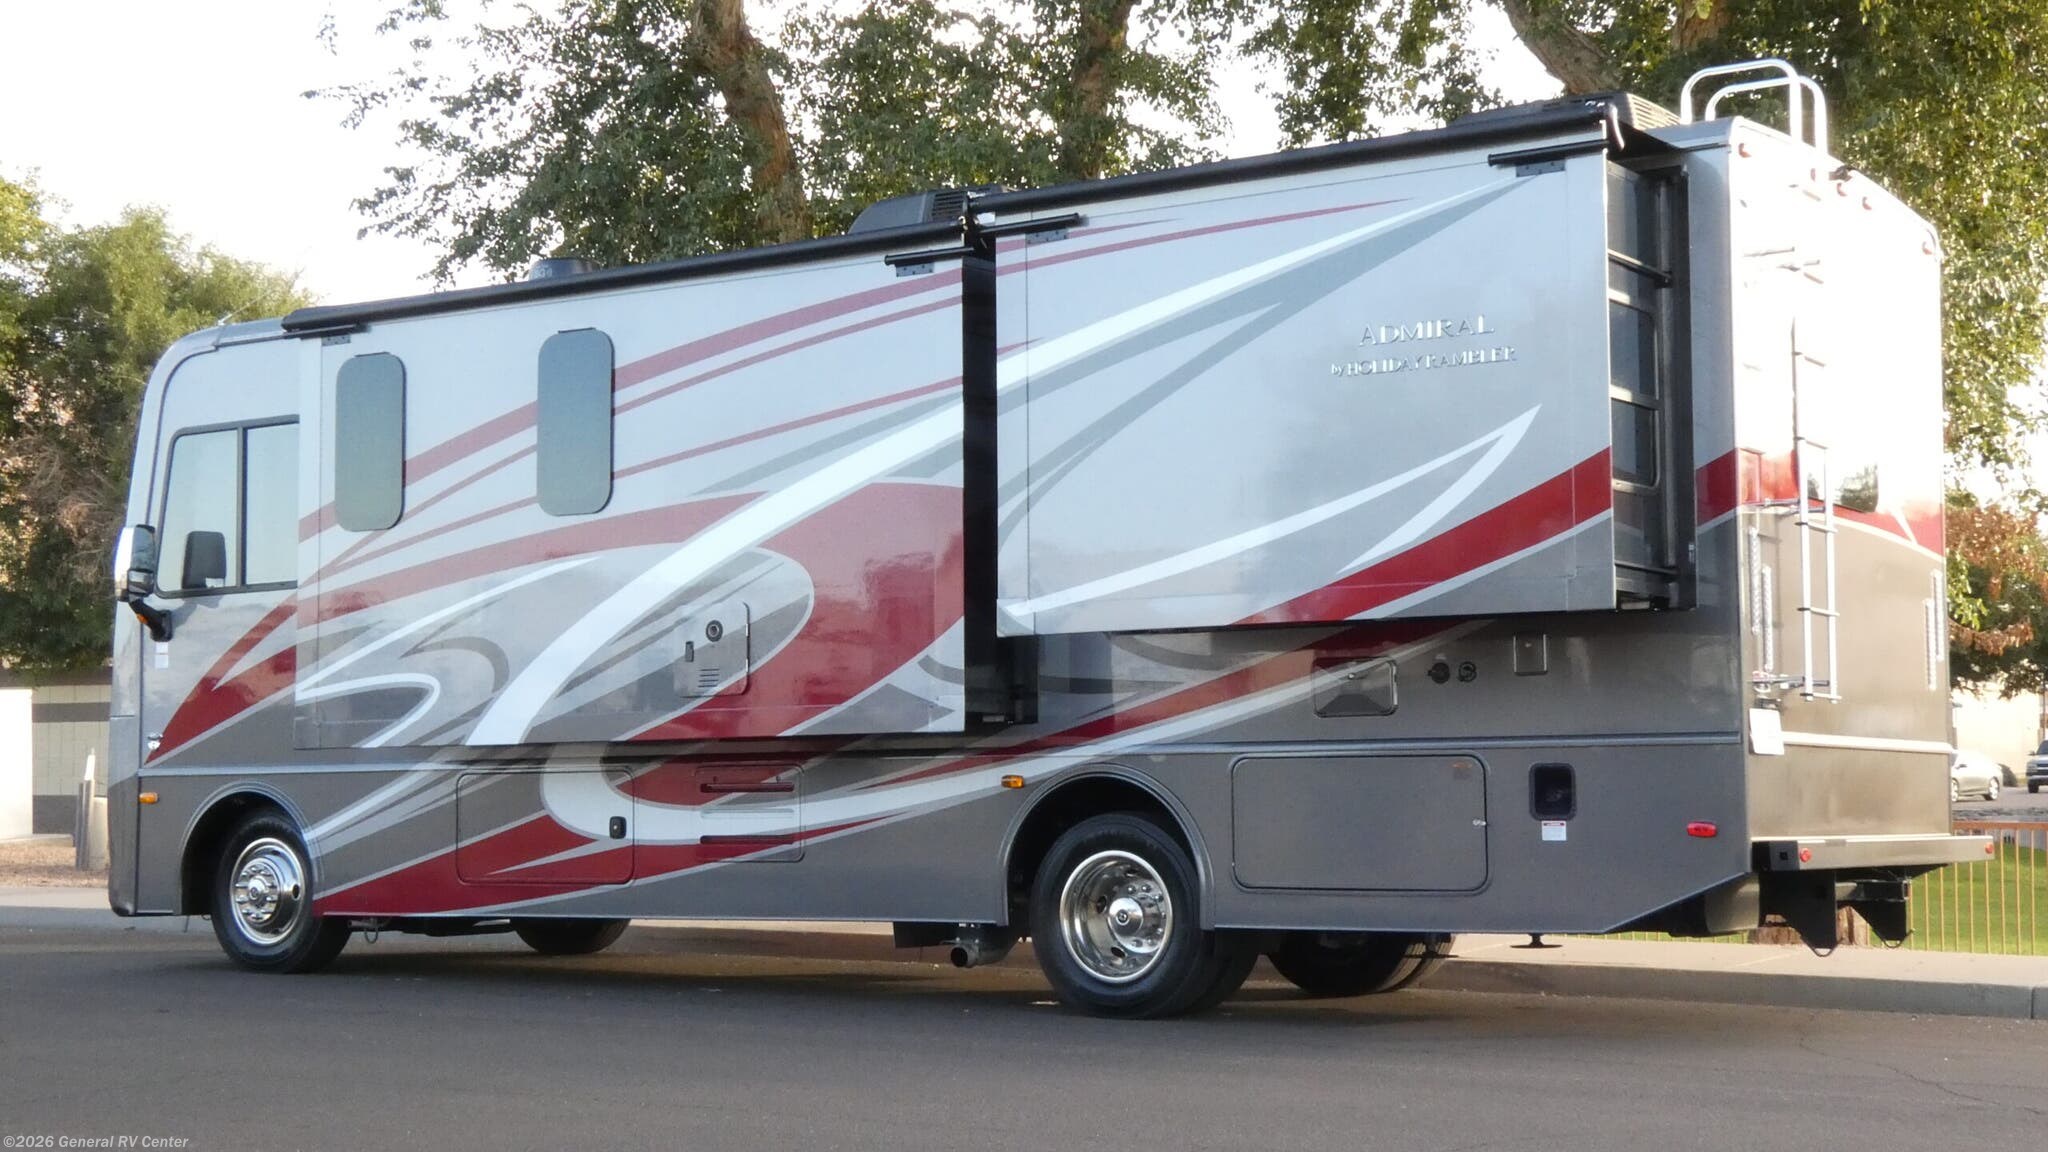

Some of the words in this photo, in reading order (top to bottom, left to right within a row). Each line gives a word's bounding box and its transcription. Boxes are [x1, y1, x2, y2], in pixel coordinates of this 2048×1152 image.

[1359, 314, 1495, 347] ADMIRAL
[1331, 363, 1344, 377] by
[1347, 355, 1424, 376] HOLIDAY
[1425, 346, 1517, 370] RAMBLER
